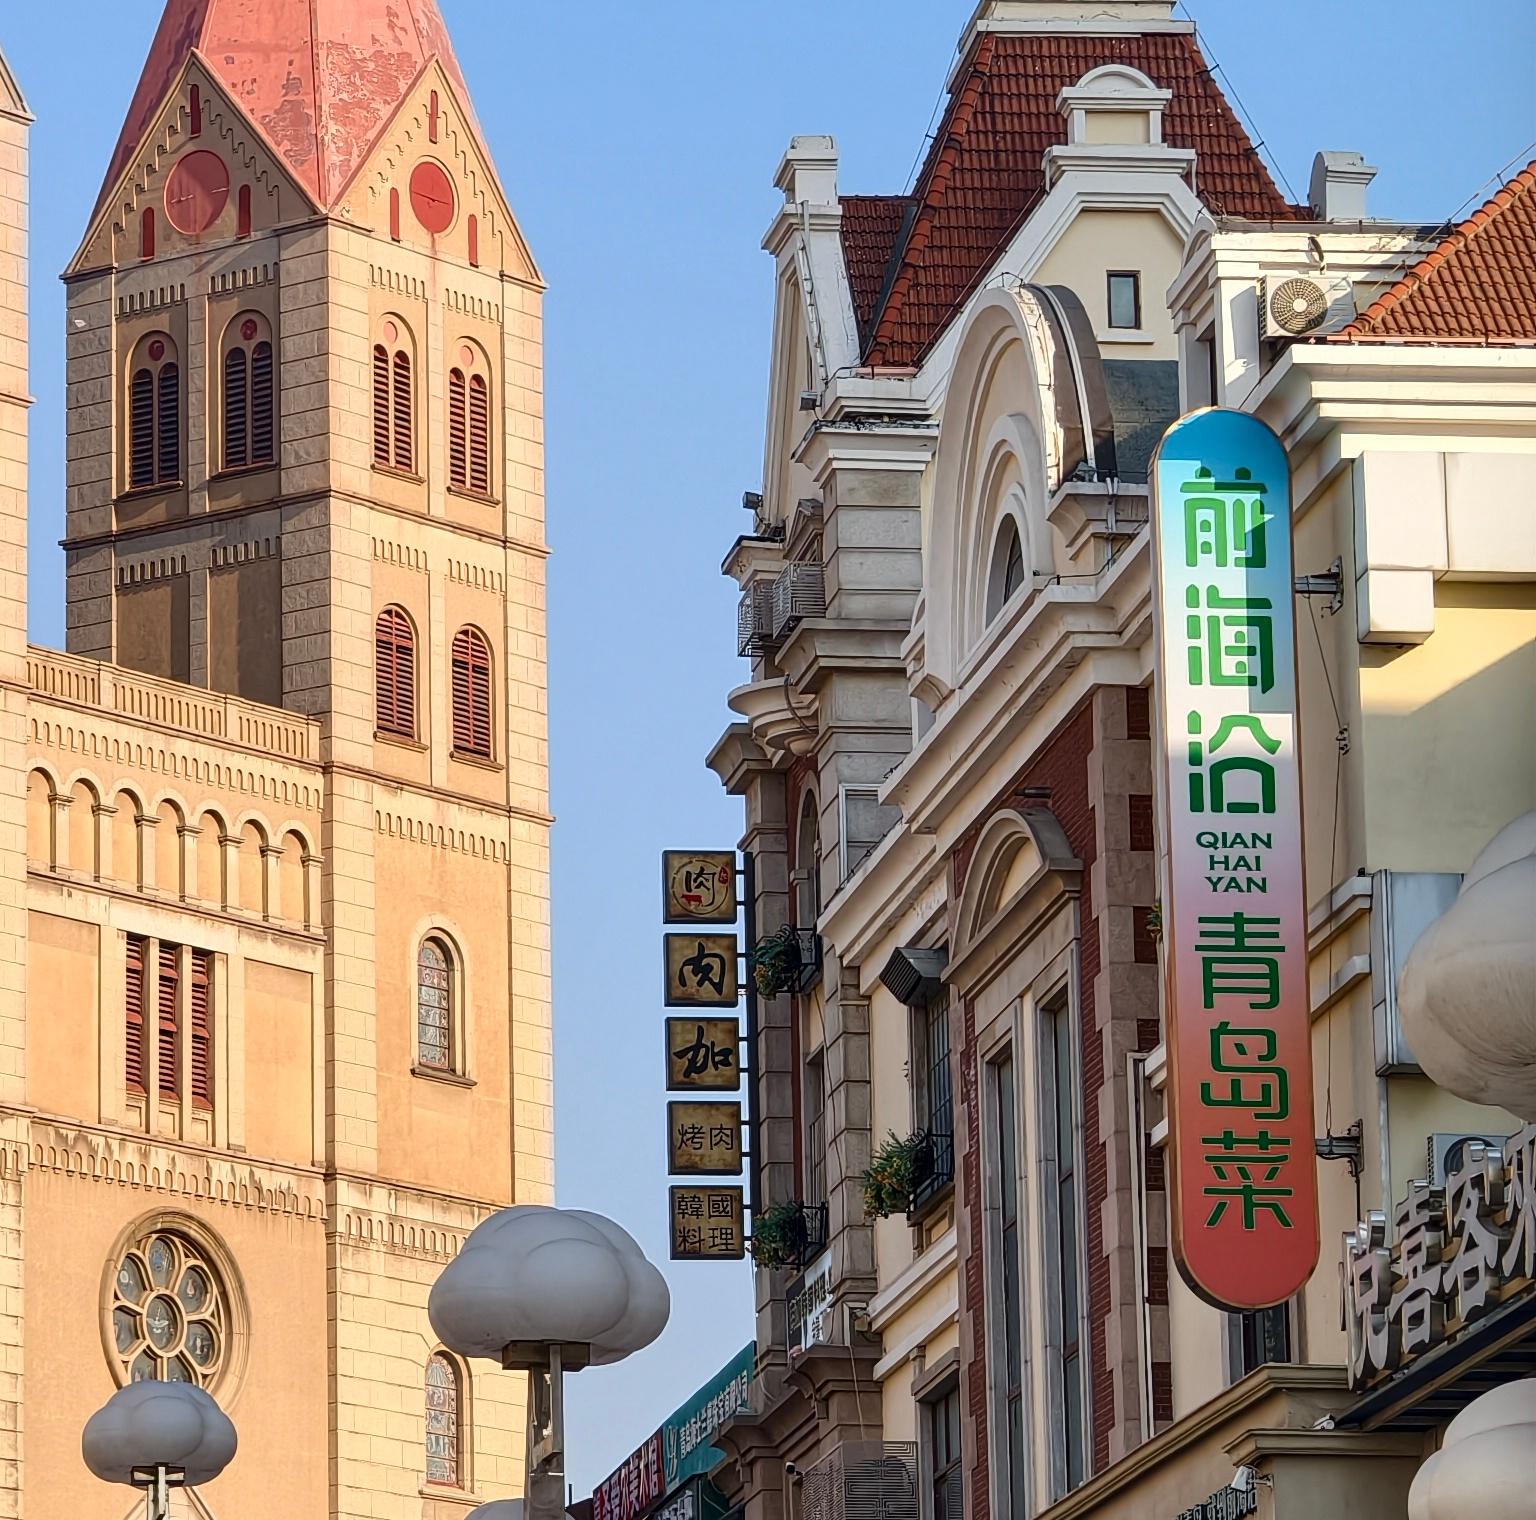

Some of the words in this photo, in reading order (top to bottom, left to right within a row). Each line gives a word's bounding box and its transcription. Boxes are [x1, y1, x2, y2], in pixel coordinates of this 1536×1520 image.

[1181, 466, 1281, 815] 前海沿
[1195, 832, 1273, 850] QIAN
[1209, 854, 1262, 872] HAI
[1205, 876, 1267, 893] YAN
[1195, 911, 1293, 1231] 青岛菜
[677, 1124, 734, 1151] 烤肉
[677, 1192, 734, 1221] 韓國
[677, 1225, 736, 1253] 料理
